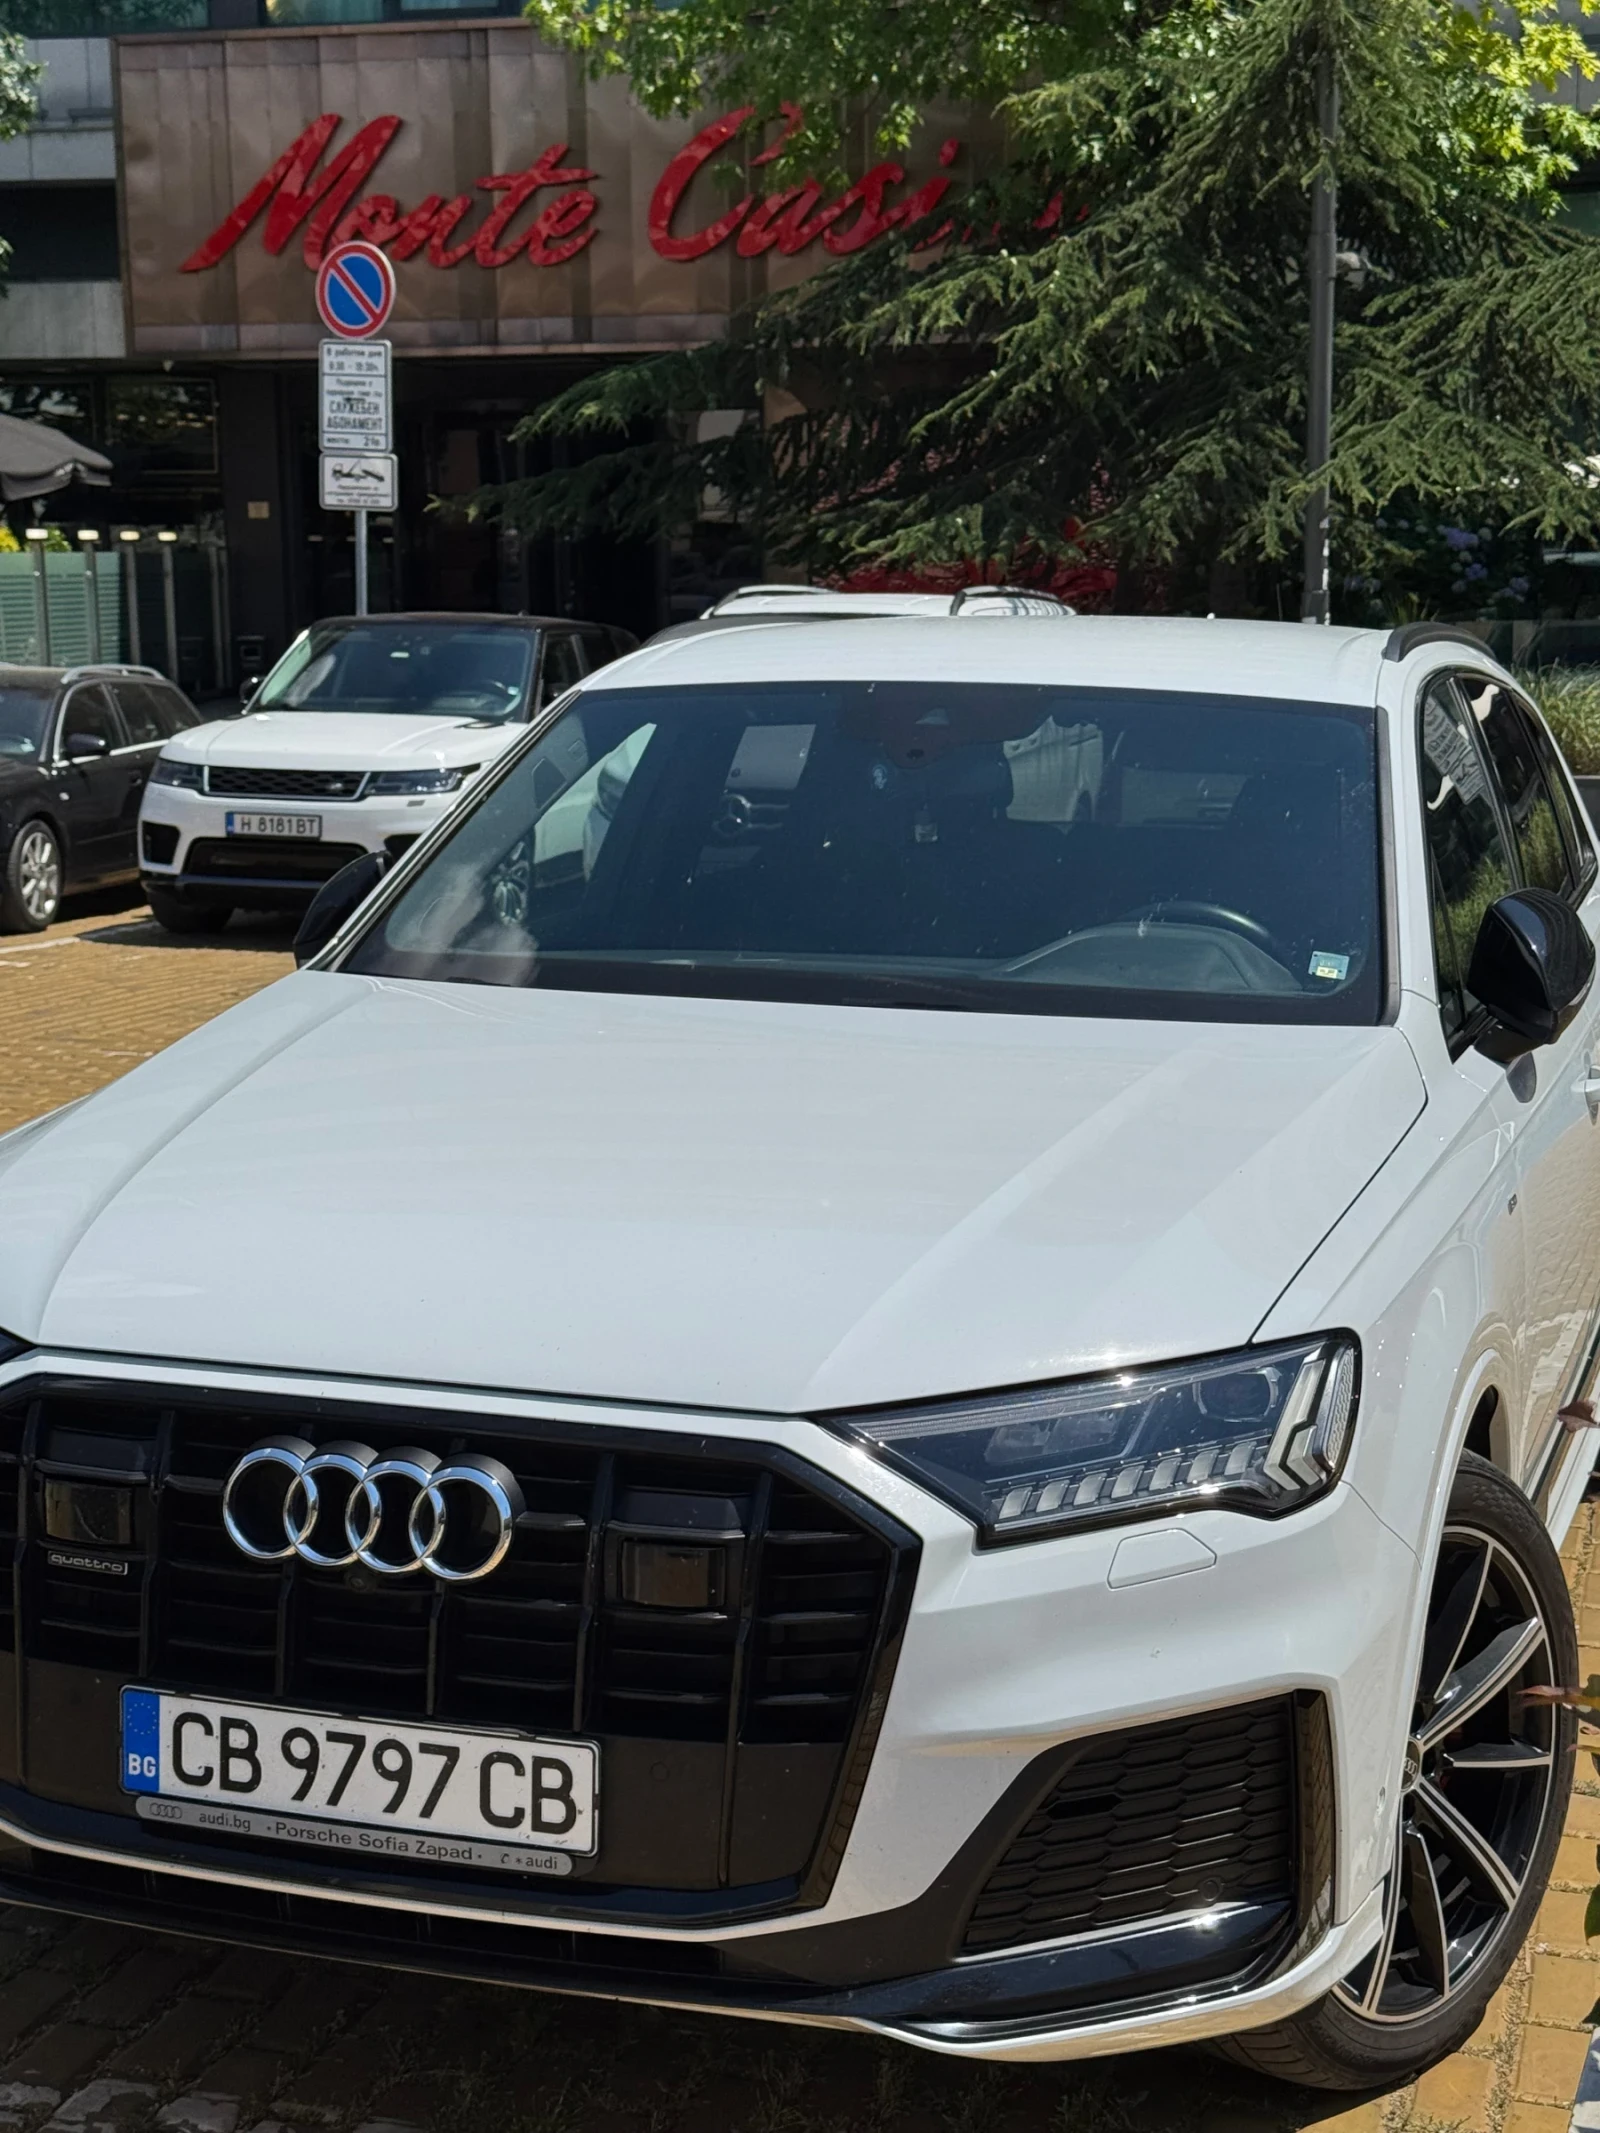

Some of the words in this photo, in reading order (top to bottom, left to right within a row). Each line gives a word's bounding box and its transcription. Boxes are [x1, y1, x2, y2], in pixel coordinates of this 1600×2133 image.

[178, 112, 601, 275] Monte
[326, 415, 383, 431] АБОНАМЕНТ
[241, 816, 251, 832] H
[51, 1554, 123, 1573] quattro
[128, 1753, 156, 1777] BG
[172, 1711, 262, 1794] CB
[281, 1726, 461, 1819] 9797
[479, 1751, 577, 1835] CB
[199, 1811, 251, 1832] audi.bg
[275, 1821, 352, 1846] Porsche
[358, 1833, 409, 1853] Sofia
[415, 1840, 473, 1860] Zapad
